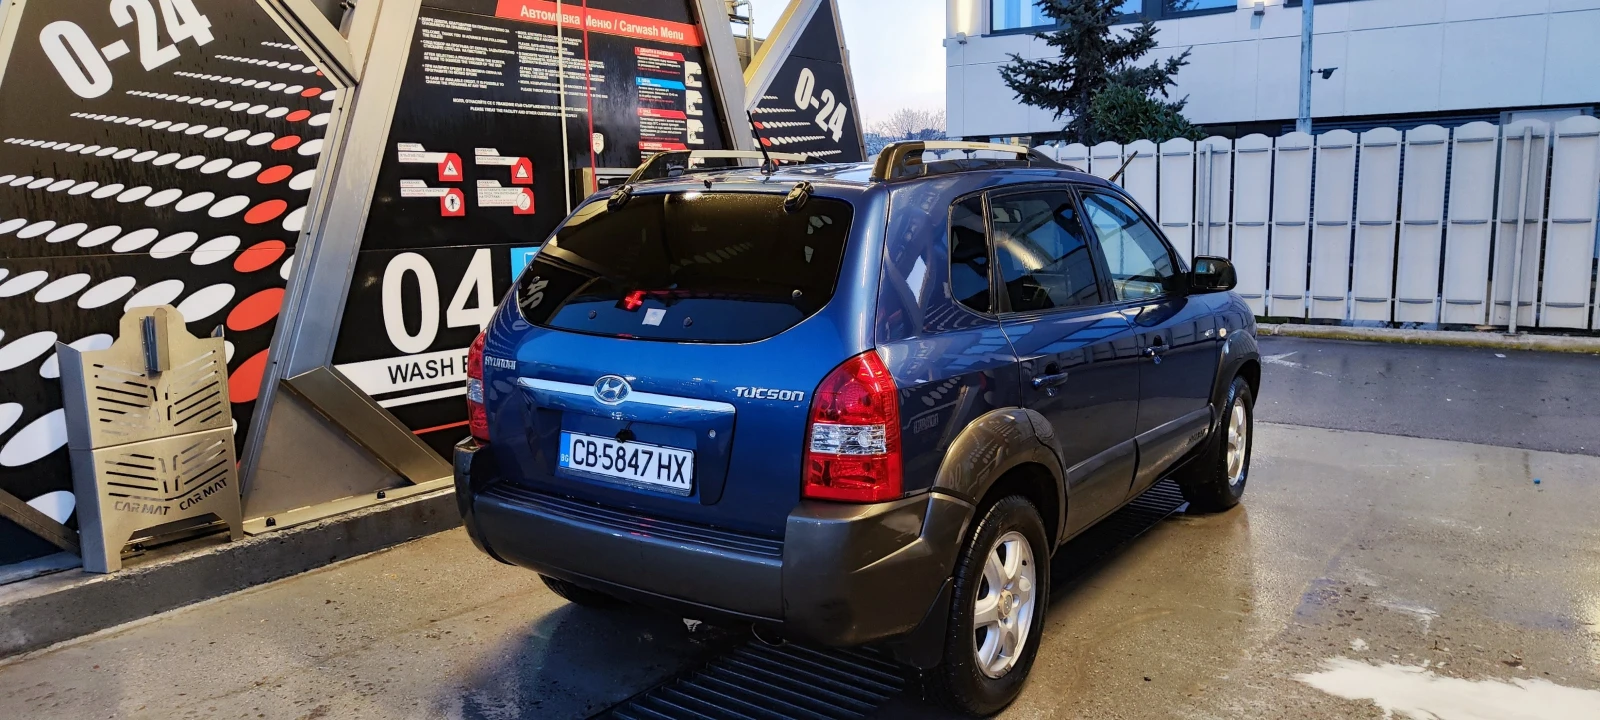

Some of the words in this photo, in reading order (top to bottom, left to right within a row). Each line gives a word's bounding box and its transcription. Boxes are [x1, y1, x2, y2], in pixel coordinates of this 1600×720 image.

[586, 15, 612, 30] Меню
[620, 21, 658, 36] Carwash
[660, 27, 684, 40] Menu
[39, 0, 214, 98] 0-24
[795, 67, 847, 143] 0-24
[382, 249, 498, 353] 04
[388, 357, 454, 384] WASH
[485, 356, 516, 370] HYUNDAI
[735, 387, 804, 401] TUCSON
[560, 454, 569, 462] BG
[180, 493, 203, 510] CAR
[203, 478, 228, 497] MAT
[115, 501, 140, 513] CAR
[142, 504, 170, 515] MAT
